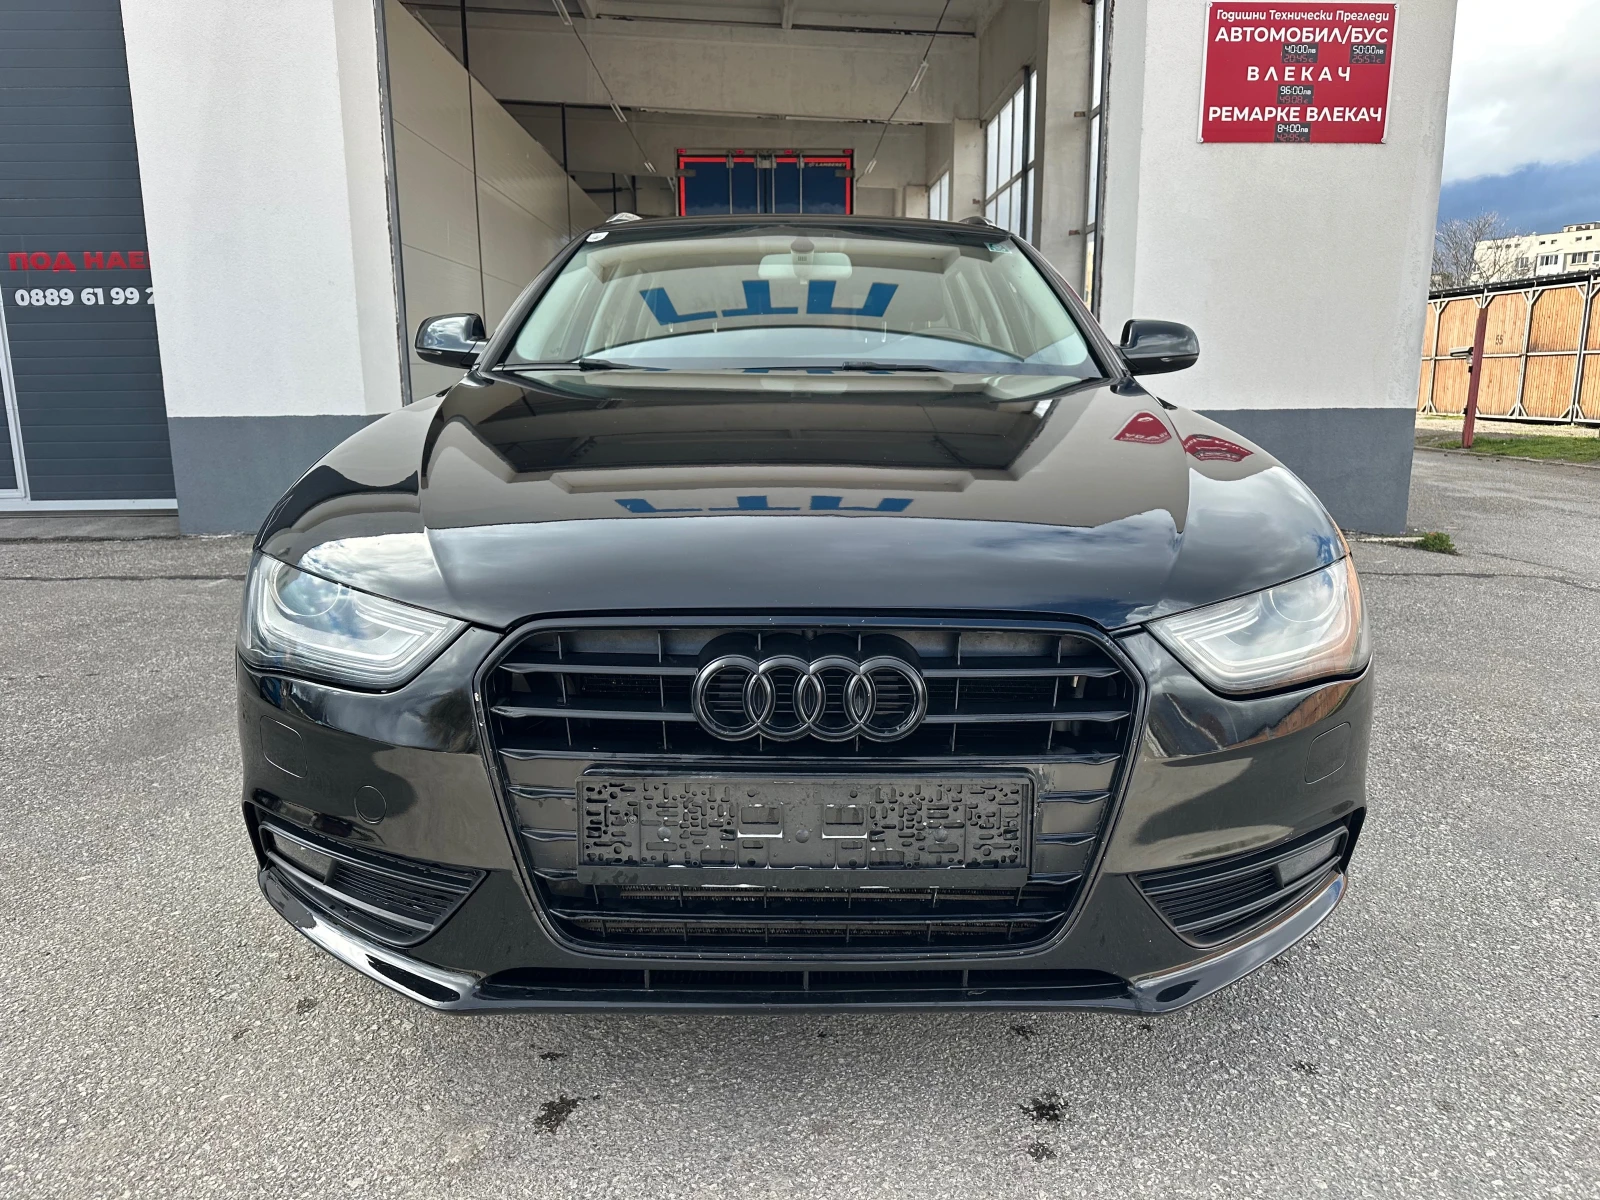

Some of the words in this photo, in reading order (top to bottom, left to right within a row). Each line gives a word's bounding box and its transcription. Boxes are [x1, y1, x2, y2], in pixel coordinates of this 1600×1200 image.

[1217, 9, 1266, 22] Годишни
[1269, 10, 1333, 21] Технически
[1335, 10, 1389, 23] Прегледи
[1215, 25, 1389, 44] АВТОМОБИЛ/БУС
[1208, 107, 1301, 122] РЕМАРКЕ
[1306, 107, 1382, 122] ВЛЕКАЧ
[8, 251, 76, 273] ПОД
[83, 251, 151, 270] НАЕ
[14, 287, 74, 306] 0889
[80, 287, 104, 305] 61
[110, 287, 140, 305] 99
